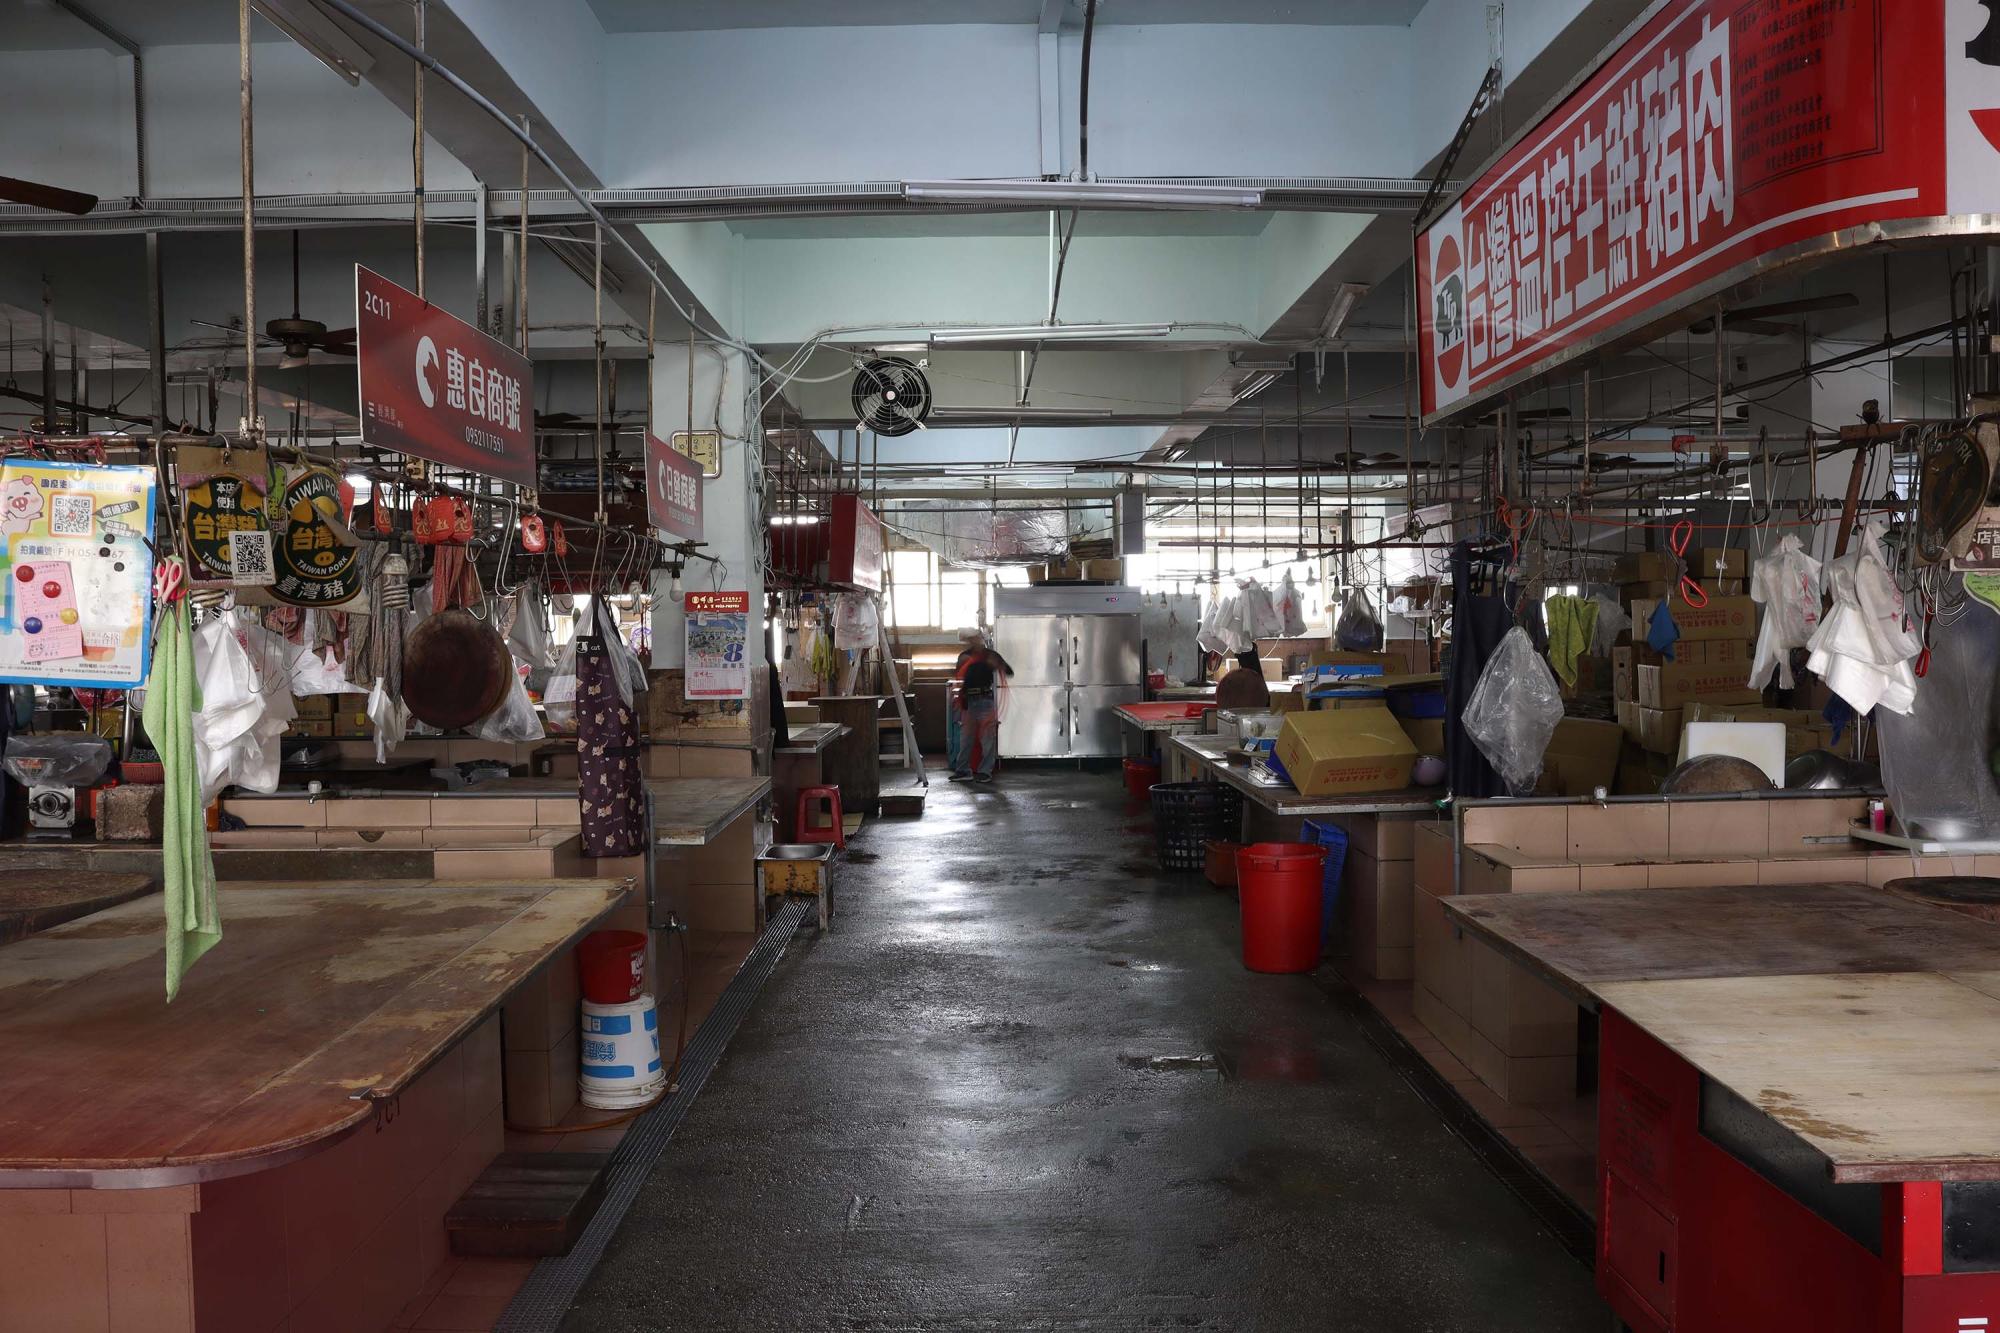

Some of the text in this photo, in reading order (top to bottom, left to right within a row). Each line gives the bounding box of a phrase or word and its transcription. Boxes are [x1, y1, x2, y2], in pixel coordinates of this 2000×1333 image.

[1466, 13, 1734, 370] 台灣溫控生鮮豬肉
[365, 289, 390, 321] 2C11
[446, 347, 522, 433] 惠良商號
[465, 425, 504, 455] 0952117551
[289, 477, 323, 508] AIWAN
[292, 525, 335, 551] 台灣
[296, 555, 349, 576] TAIWAN PORK
[276, 574, 345, 600] 臺灣豬
